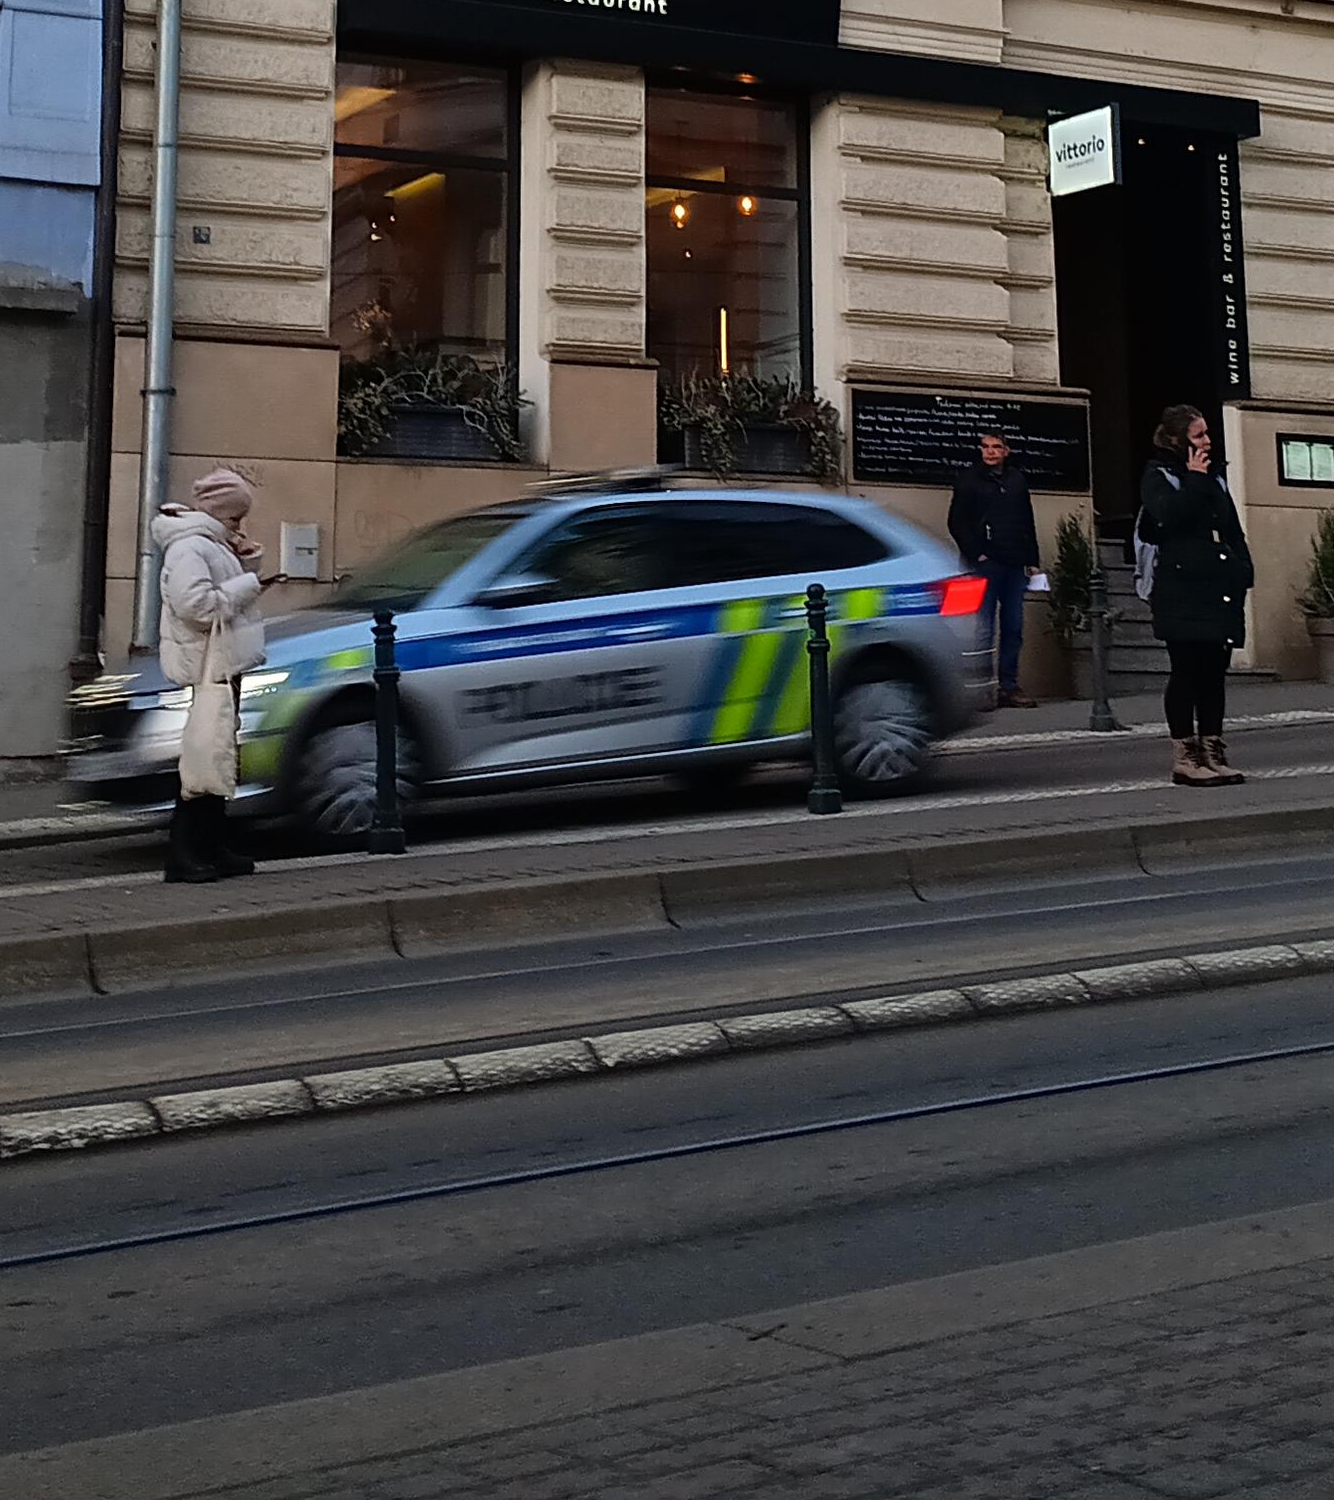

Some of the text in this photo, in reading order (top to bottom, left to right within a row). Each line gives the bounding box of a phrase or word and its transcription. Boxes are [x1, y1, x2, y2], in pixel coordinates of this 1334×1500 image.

[1055, 134, 1105, 163] vittorio
[1218, 153, 1233, 262] restaurant
[1225, 295, 1236, 329] bar
[1228, 339, 1240, 385] wine
